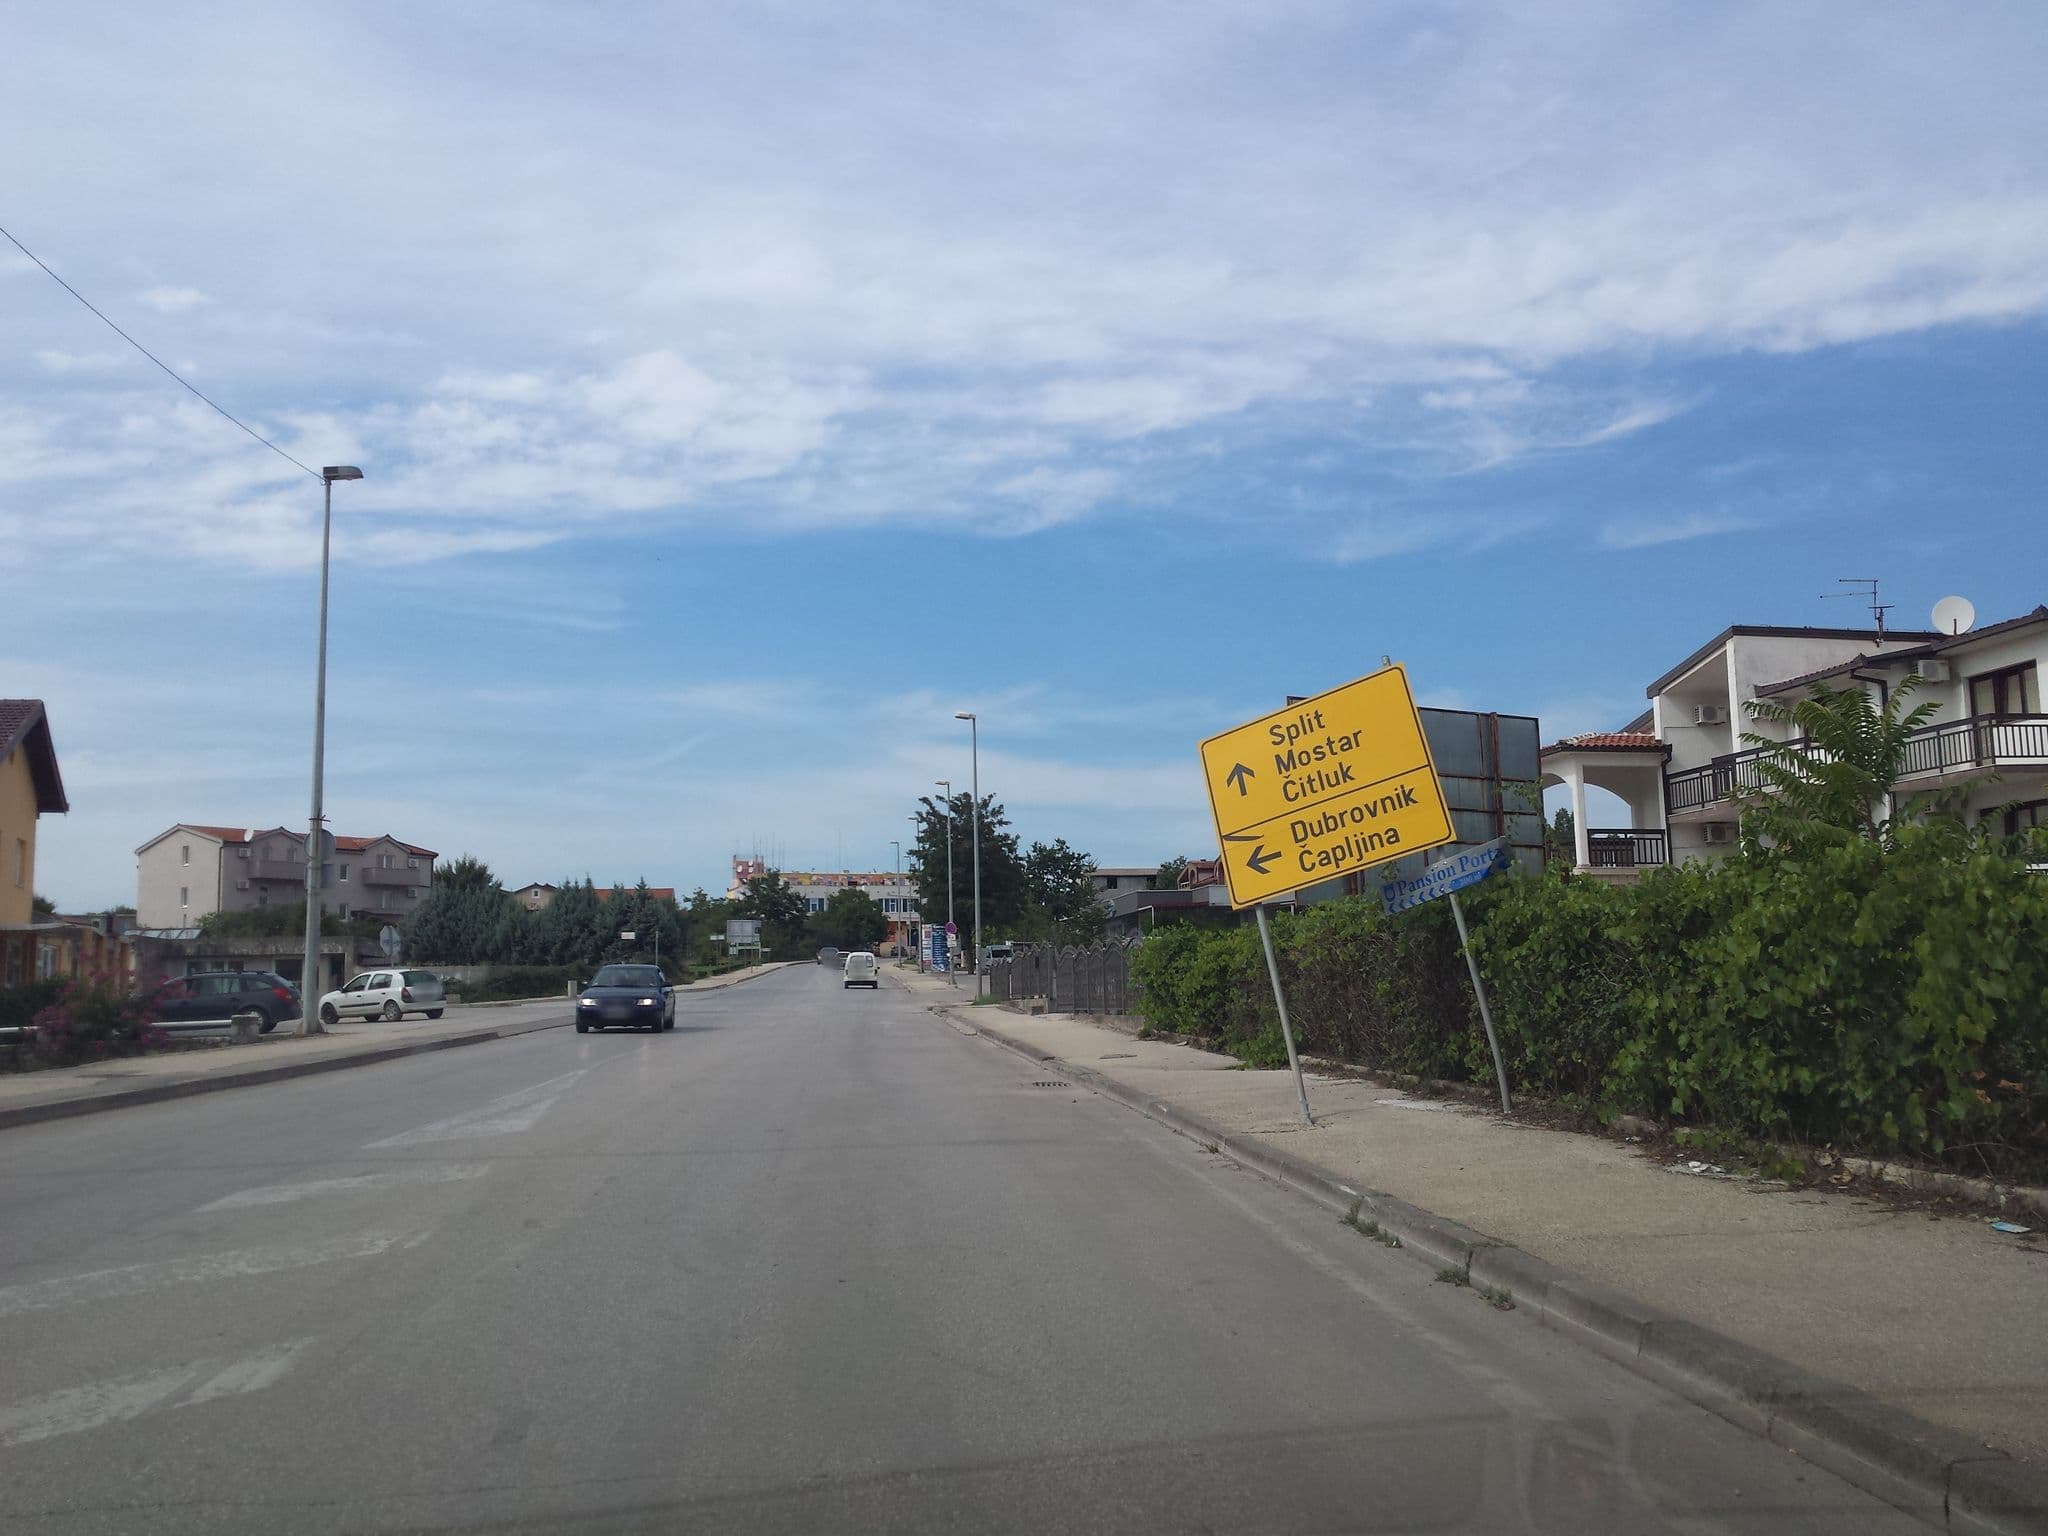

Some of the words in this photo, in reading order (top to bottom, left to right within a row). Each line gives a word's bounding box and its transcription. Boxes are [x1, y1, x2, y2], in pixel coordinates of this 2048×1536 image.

[1269, 709, 1326, 749] Split
[1274, 731, 1362, 775] Mostar
[1282, 763, 1356, 802] Čitluk
[1290, 784, 1419, 844] Dubrovnik
[1298, 827, 1400, 872] Čapljina
[1397, 866, 1456, 896] Pansion
